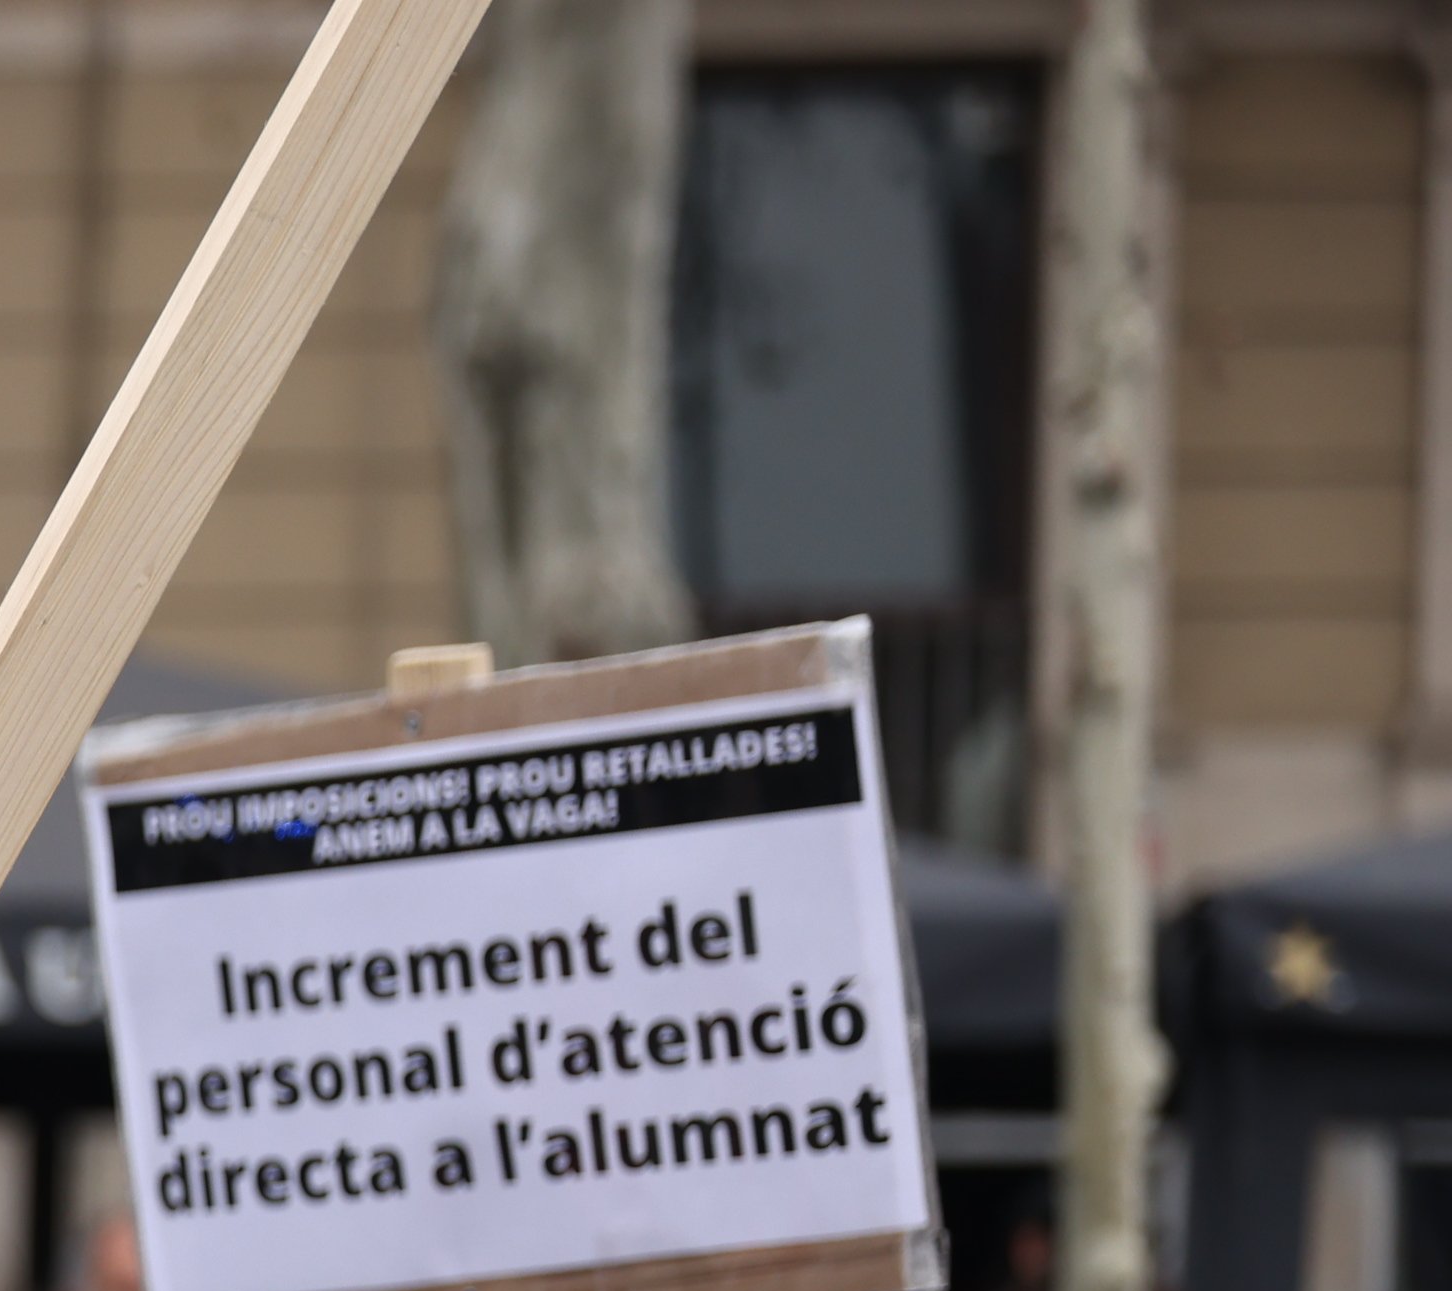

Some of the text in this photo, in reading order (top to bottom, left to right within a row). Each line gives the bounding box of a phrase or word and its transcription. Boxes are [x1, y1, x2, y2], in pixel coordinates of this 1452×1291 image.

[143, 799, 234, 844] PROU
[237, 767, 469, 833] IMPOSICIONS!
[476, 754, 574, 799] PROU
[582, 721, 818, 790] RETALLADES!
[311, 813, 416, 866] ANEM
[419, 810, 449, 850] A
[452, 805, 502, 847] LA
[504, 790, 620, 840] VAGA!
[219, 918, 612, 1018] Increment
[638, 892, 759, 969] del
[154, 975, 868, 1136] personal d'atenció
[158, 1087, 892, 1215] directa a l'alumnat
